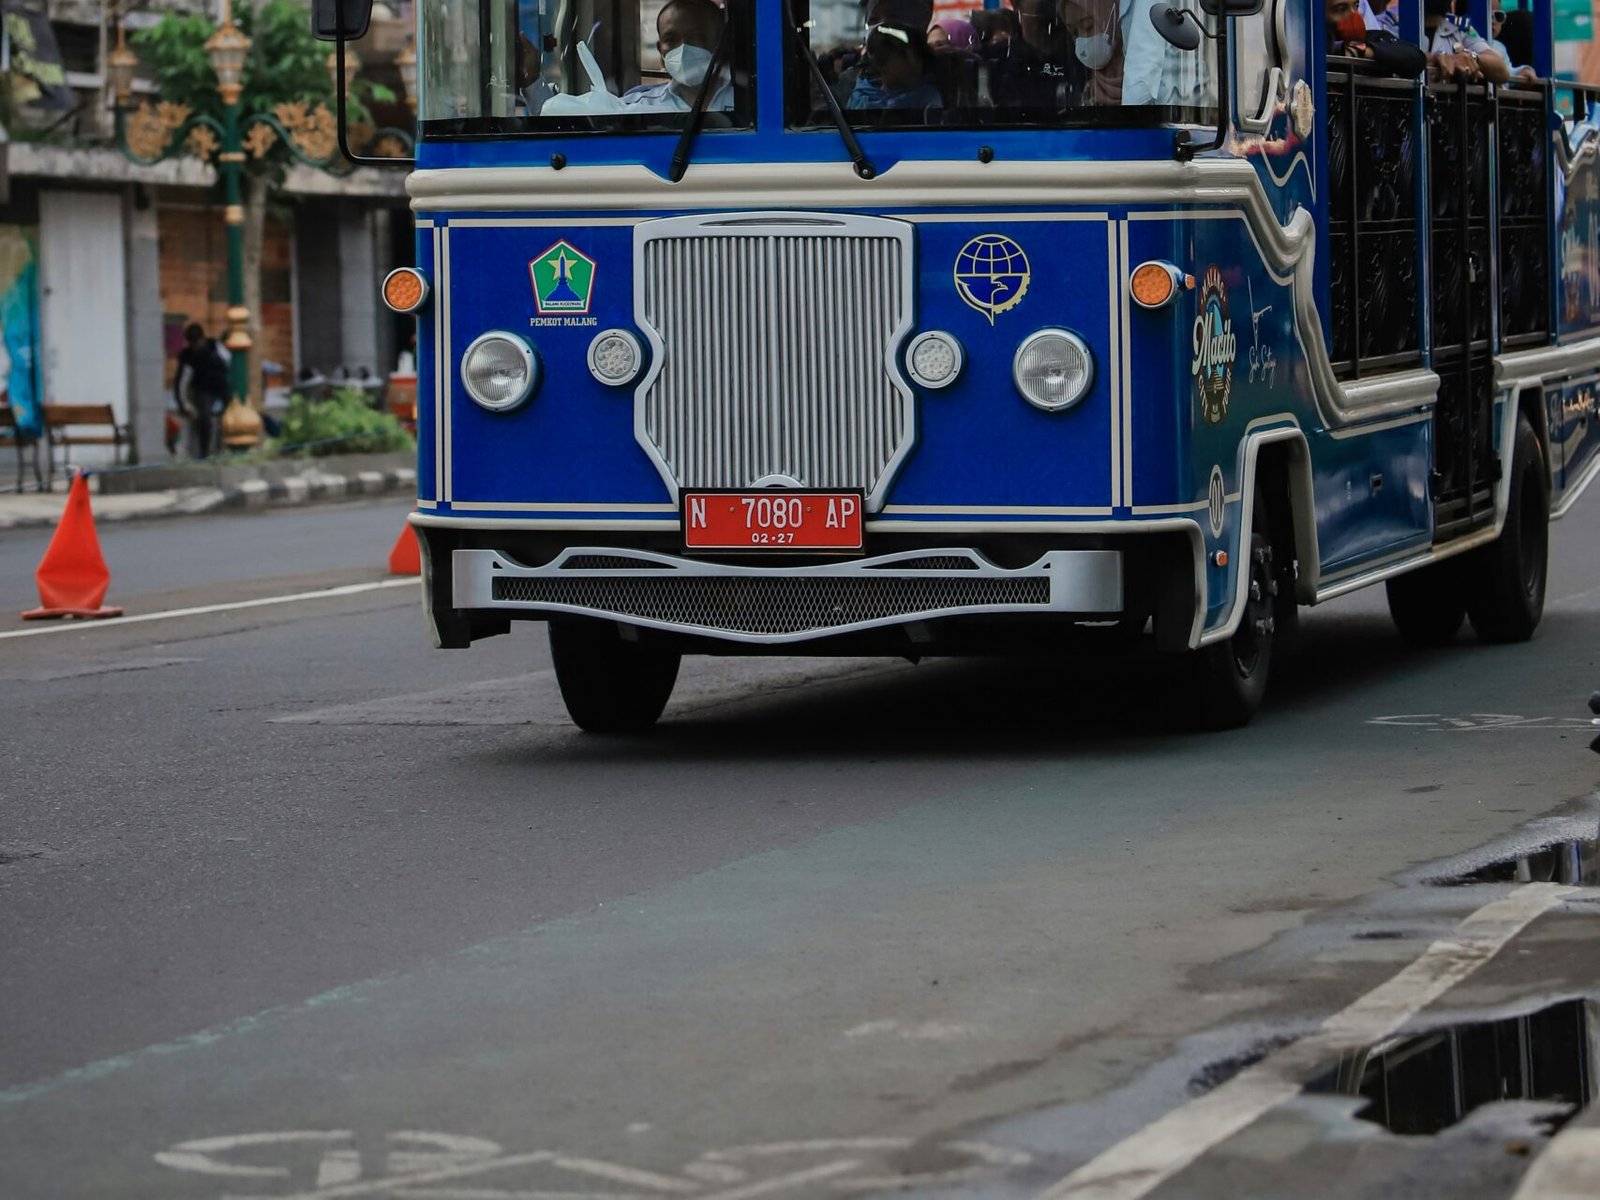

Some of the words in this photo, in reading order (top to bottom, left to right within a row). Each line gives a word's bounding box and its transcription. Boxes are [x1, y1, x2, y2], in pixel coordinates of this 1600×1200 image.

[1202, 268, 1225, 303] MALANG
[530, 317, 562, 327] PEMKOT
[564, 317, 598, 326] MALANG
[1191, 311, 1237, 380] Macito
[691, 498, 707, 529] N
[741, 498, 803, 529] 7080
[825, 498, 855, 529] AP
